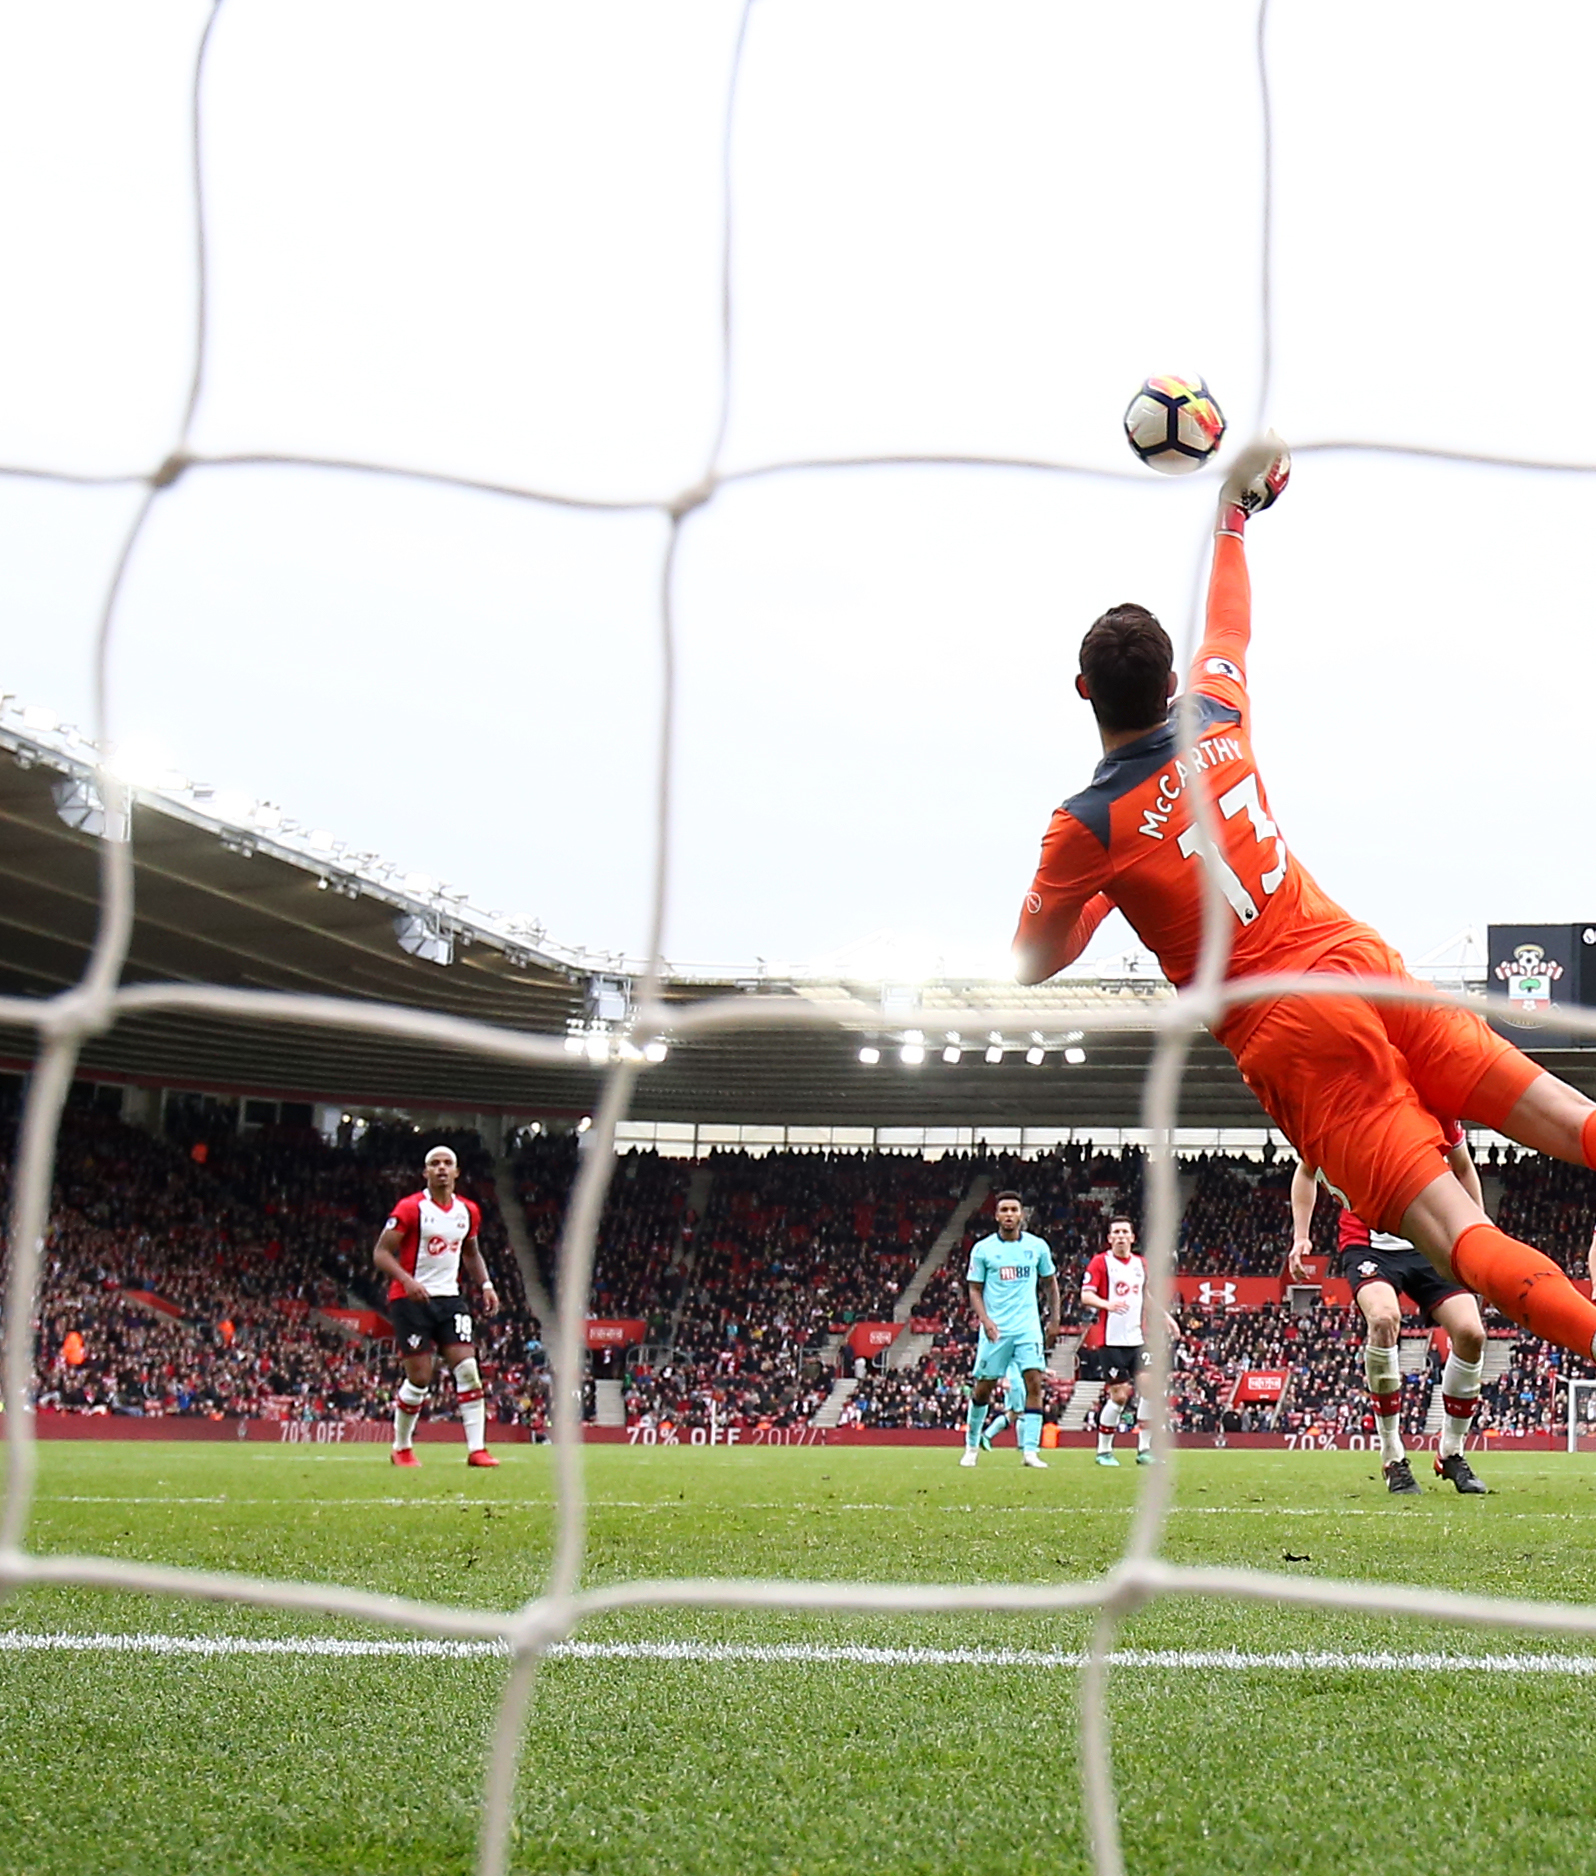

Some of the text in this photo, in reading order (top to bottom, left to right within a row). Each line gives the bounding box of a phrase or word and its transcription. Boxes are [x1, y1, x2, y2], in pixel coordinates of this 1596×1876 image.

[1138, 738, 1243, 840] McCARTHY
[1176, 773, 1287, 926] 13
[454, 1313, 472, 1334] 18
[280, 1422, 312, 1443] 70%
[316, 1422, 346, 1443] OFF
[627, 1427, 679, 1445] 70%
[690, 1428, 741, 1446] OFF
[1284, 1434, 1338, 1451] 70%
